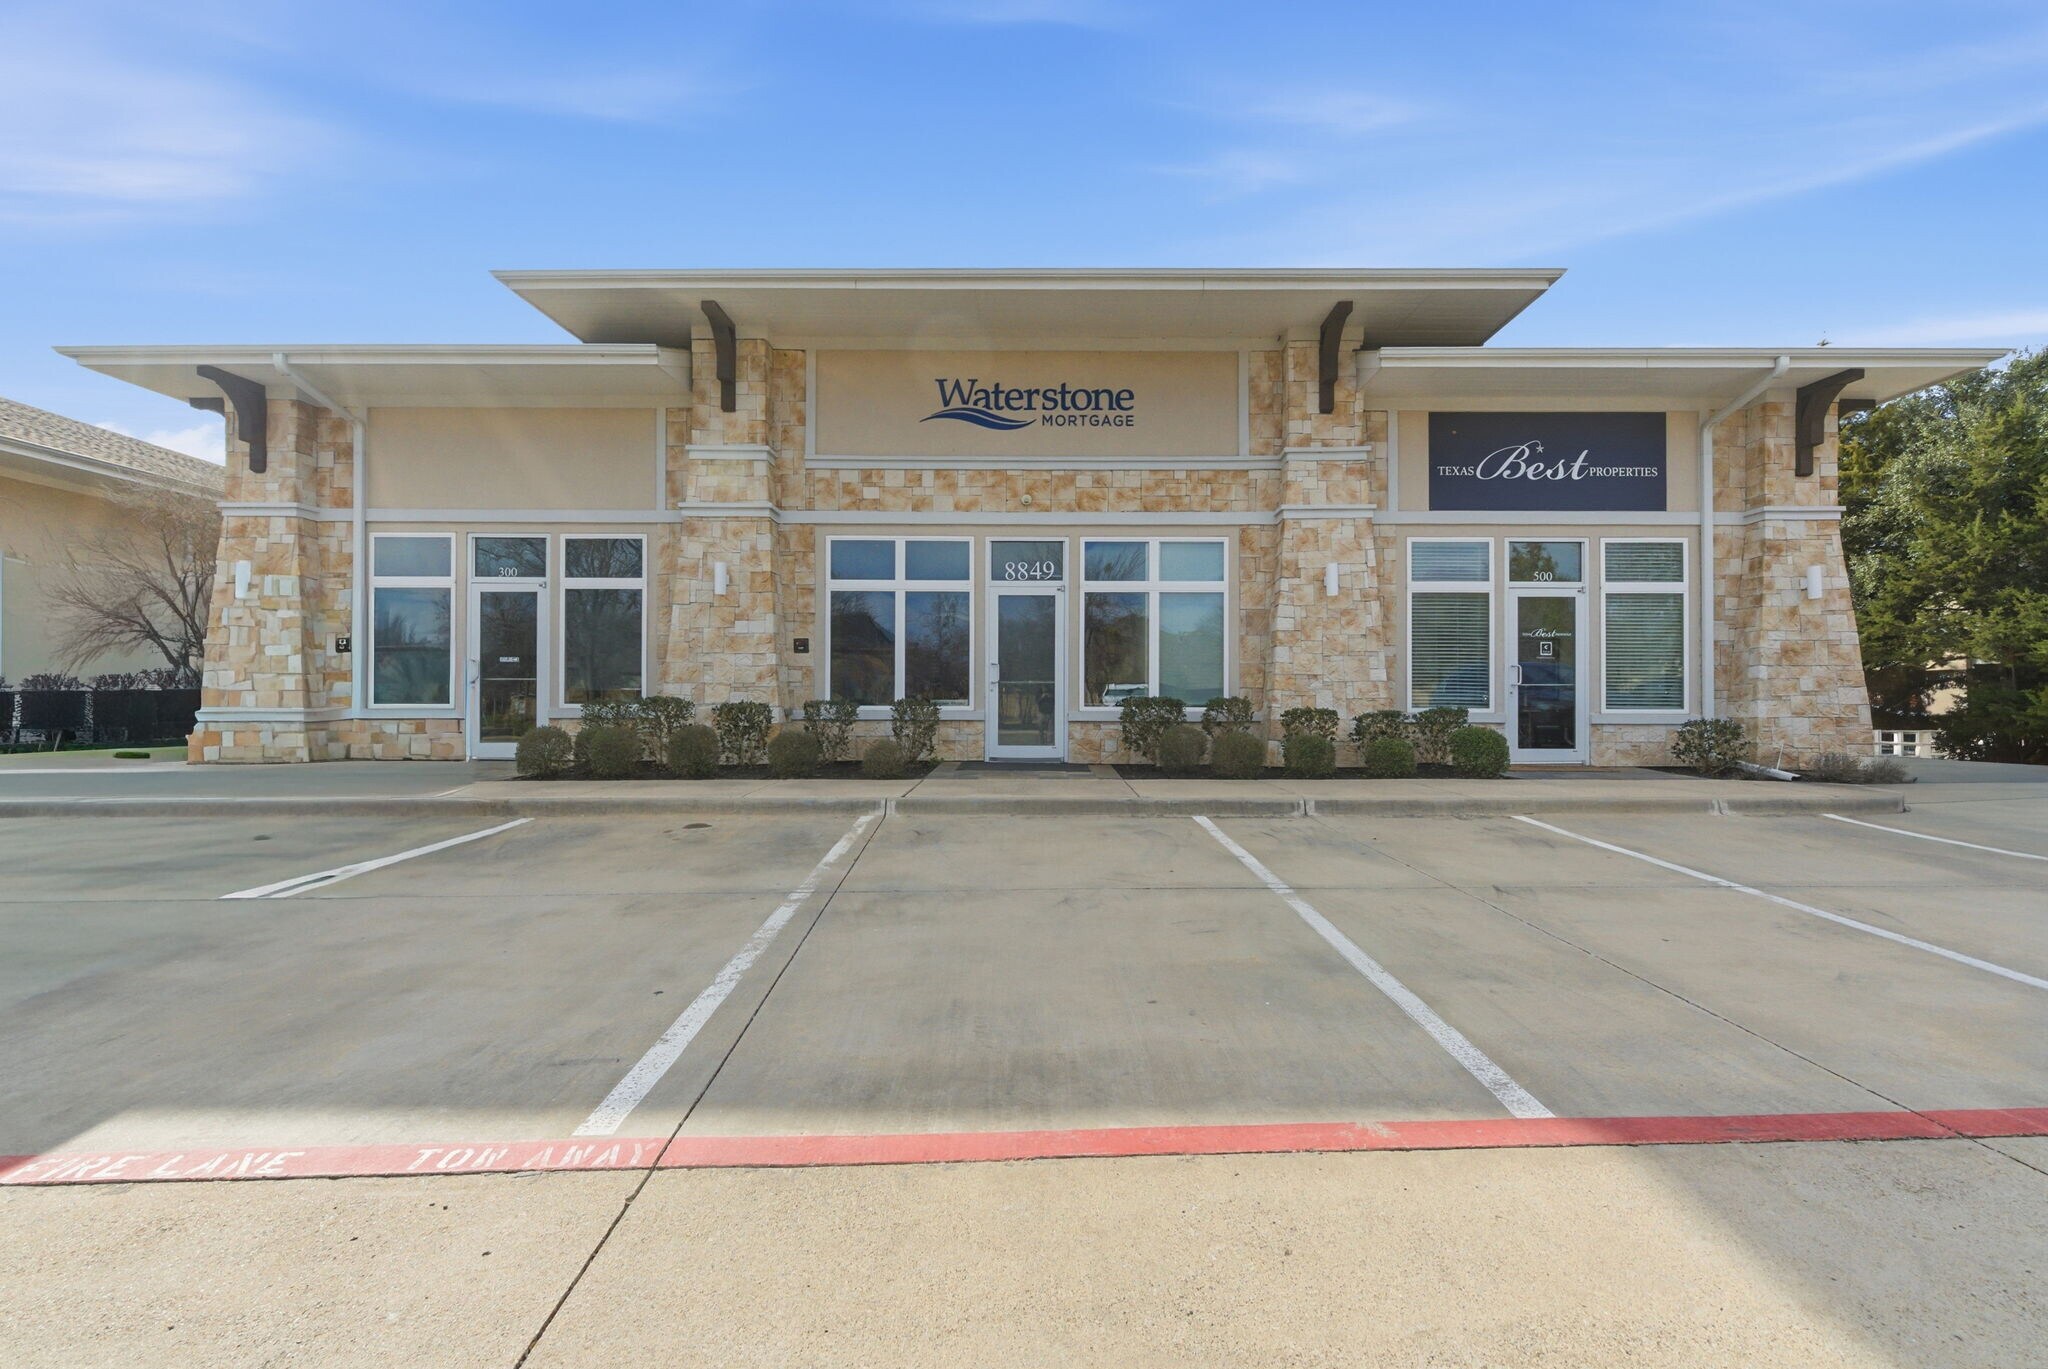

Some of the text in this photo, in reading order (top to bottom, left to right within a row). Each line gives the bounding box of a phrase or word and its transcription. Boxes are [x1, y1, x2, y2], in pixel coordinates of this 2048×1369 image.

[935, 378, 1135, 411] Waterstone
[1042, 414, 1135, 427] MORTGAGE
[1437, 440, 1659, 481] TEXAS Best PROPERTIES
[498, 567, 518, 577] 300
[1004, 561, 1055, 581] 8849
[1533, 571, 1553, 582] 500
[1, 1151, 306, 1182] FIRE LANE
[407, 1147, 509, 1171] TOW
